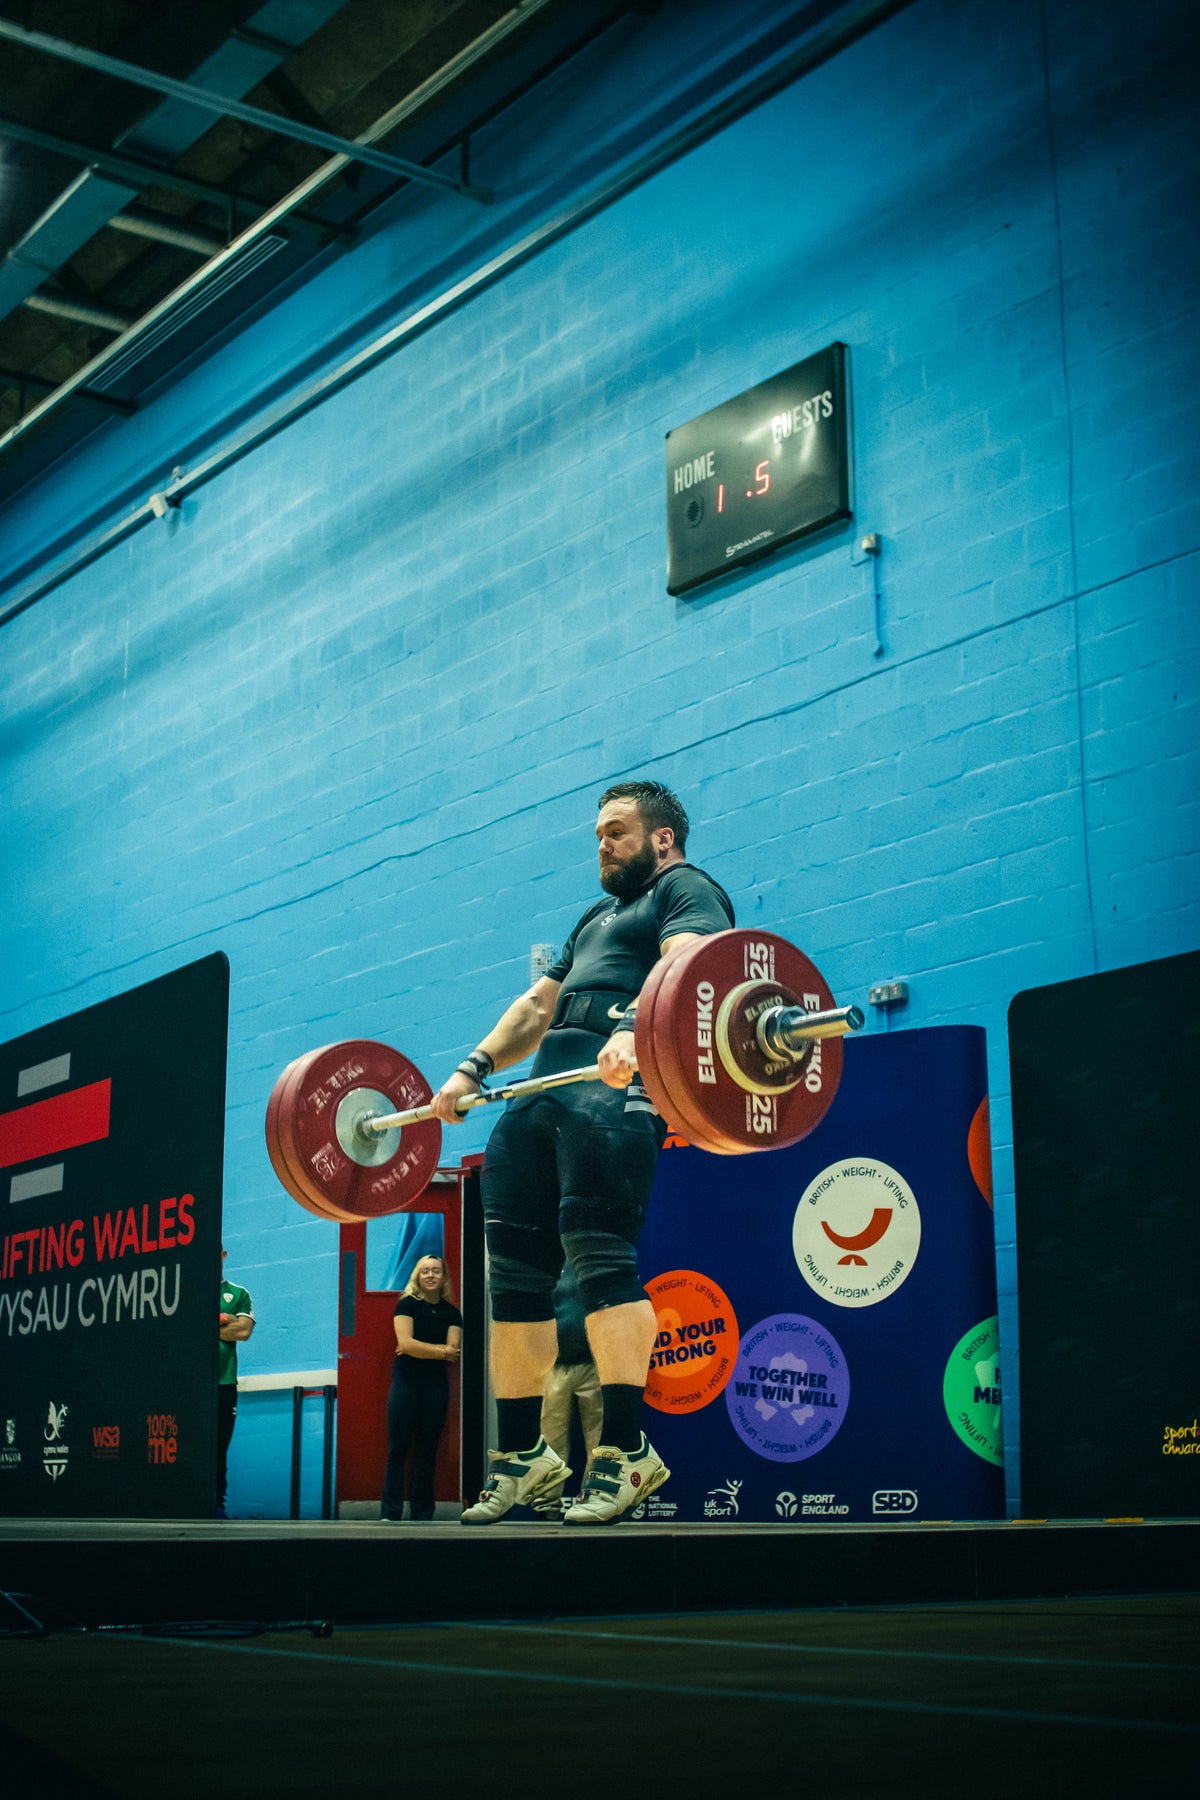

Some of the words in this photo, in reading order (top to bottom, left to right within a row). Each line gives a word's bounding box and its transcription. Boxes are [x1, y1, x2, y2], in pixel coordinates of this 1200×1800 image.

[772, 390, 833, 444] GUESTS
[674, 450, 716, 494] HOME
[750, 942, 768, 981] 25
[697, 981, 717, 1085] ELEIKO
[752, 1093, 771, 1134] 25
[809, 1176, 835, 1205] BRITISH
[842, 1166, 877, 1178] WEIGHT
[883, 1176, 908, 1209] LIFTING
[0, 1219, 85, 1279] IFTING
[93, 1193, 195, 1262] WALES
[804, 1254, 828, 1286] LIFTING
[877, 1259, 904, 1290] BRITISH
[78, 1263, 181, 1327] CYMRU
[655, 1278, 688, 1294] WEIGHT
[694, 1282, 721, 1309] LIFTING
[834, 1286, 869, 1298] WEIGHT
[676, 1317, 726, 1341] YOUR
[649, 1340, 716, 1370] STRONG
[742, 1329, 768, 1357] BRITISH
[775, 1321, 809, 1335] WEIGHT
[815, 1335, 839, 1369] LIFTING
[962, 1330, 991, 1361] BRITISH
[707, 1357, 729, 1390] BRITISH
[748, 1365, 827, 1389] TOGETHER
[670, 1391, 702, 1405] WEIGHT
[735, 1381, 761, 1398] WE
[762, 1385, 793, 1403] WIN
[798, 1389, 838, 1409] WELL
[93, 1425, 120, 1448] wsa
[147, 1414, 178, 1438] 100%
[736, 1405, 758, 1440] LIFTING
[804, 1419, 832, 1448] BRITISH
[958, 1412, 989, 1447] LIFTING
[1163, 1418, 1197, 1443] sport
[763, 1440, 798, 1454] WEIGHT
[703, 1506, 731, 1517] sport
[704, 1499, 717, 1509] uk
[801, 1494, 835, 1504] SPORT
[801, 1505, 850, 1515] ENGLAND
[874, 1492, 917, 1511] SBD
